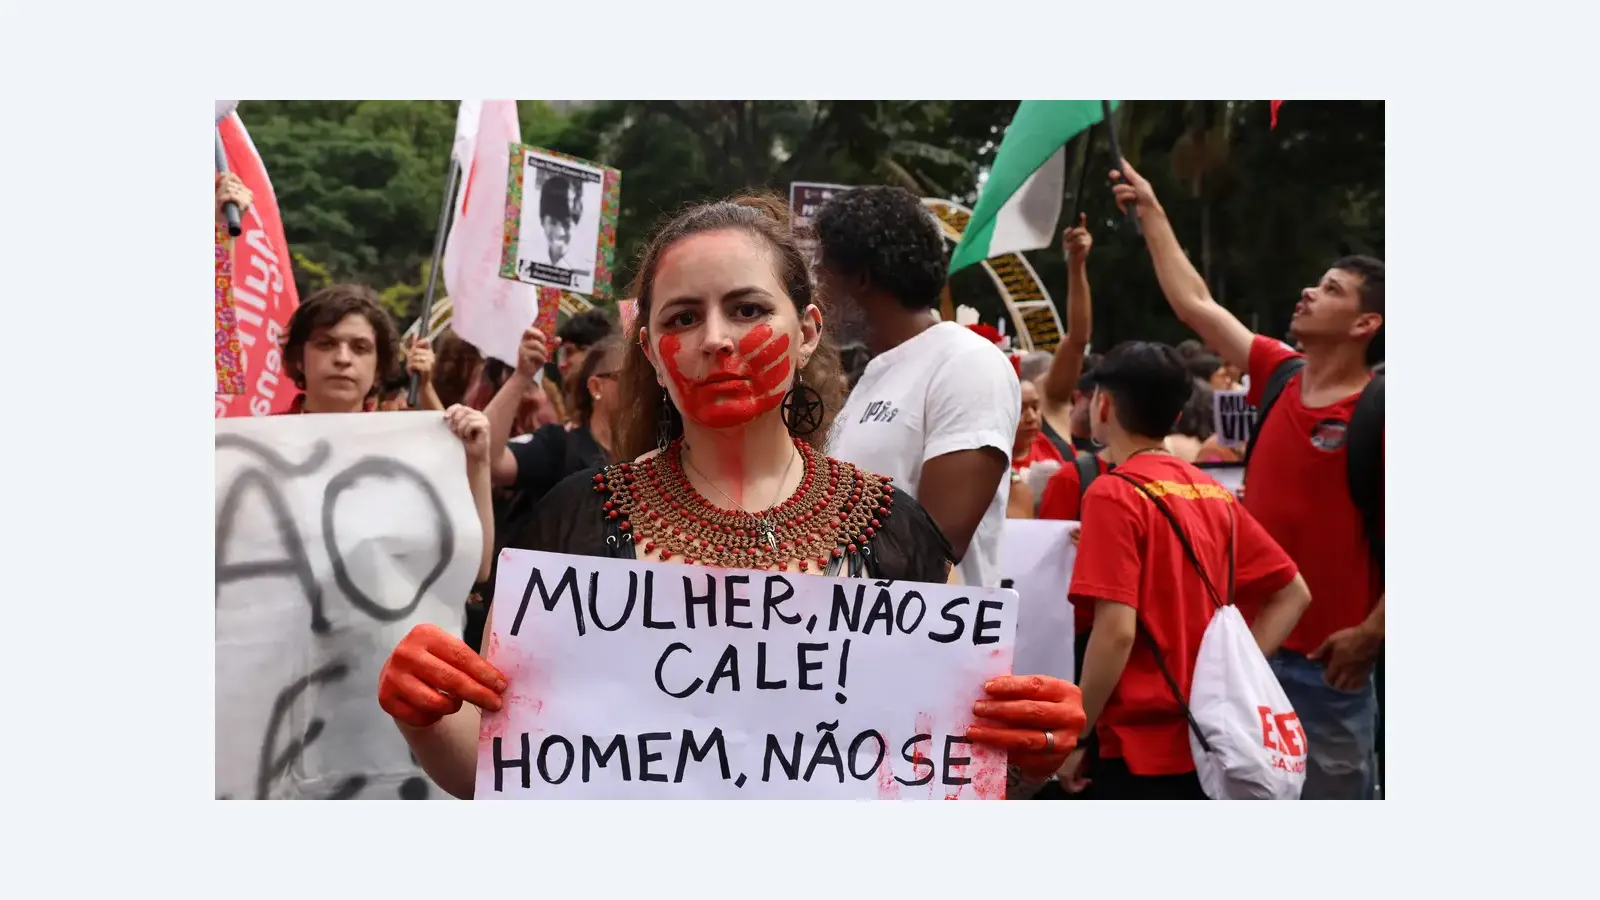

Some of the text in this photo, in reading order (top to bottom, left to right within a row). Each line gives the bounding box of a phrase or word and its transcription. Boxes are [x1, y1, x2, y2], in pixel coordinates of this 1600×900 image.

[510, 566, 1003, 646] MULHER, NÃO SE
[655, 639, 850, 704] CALE!
[493, 720, 974, 792] HOMEM, NÃO SE
